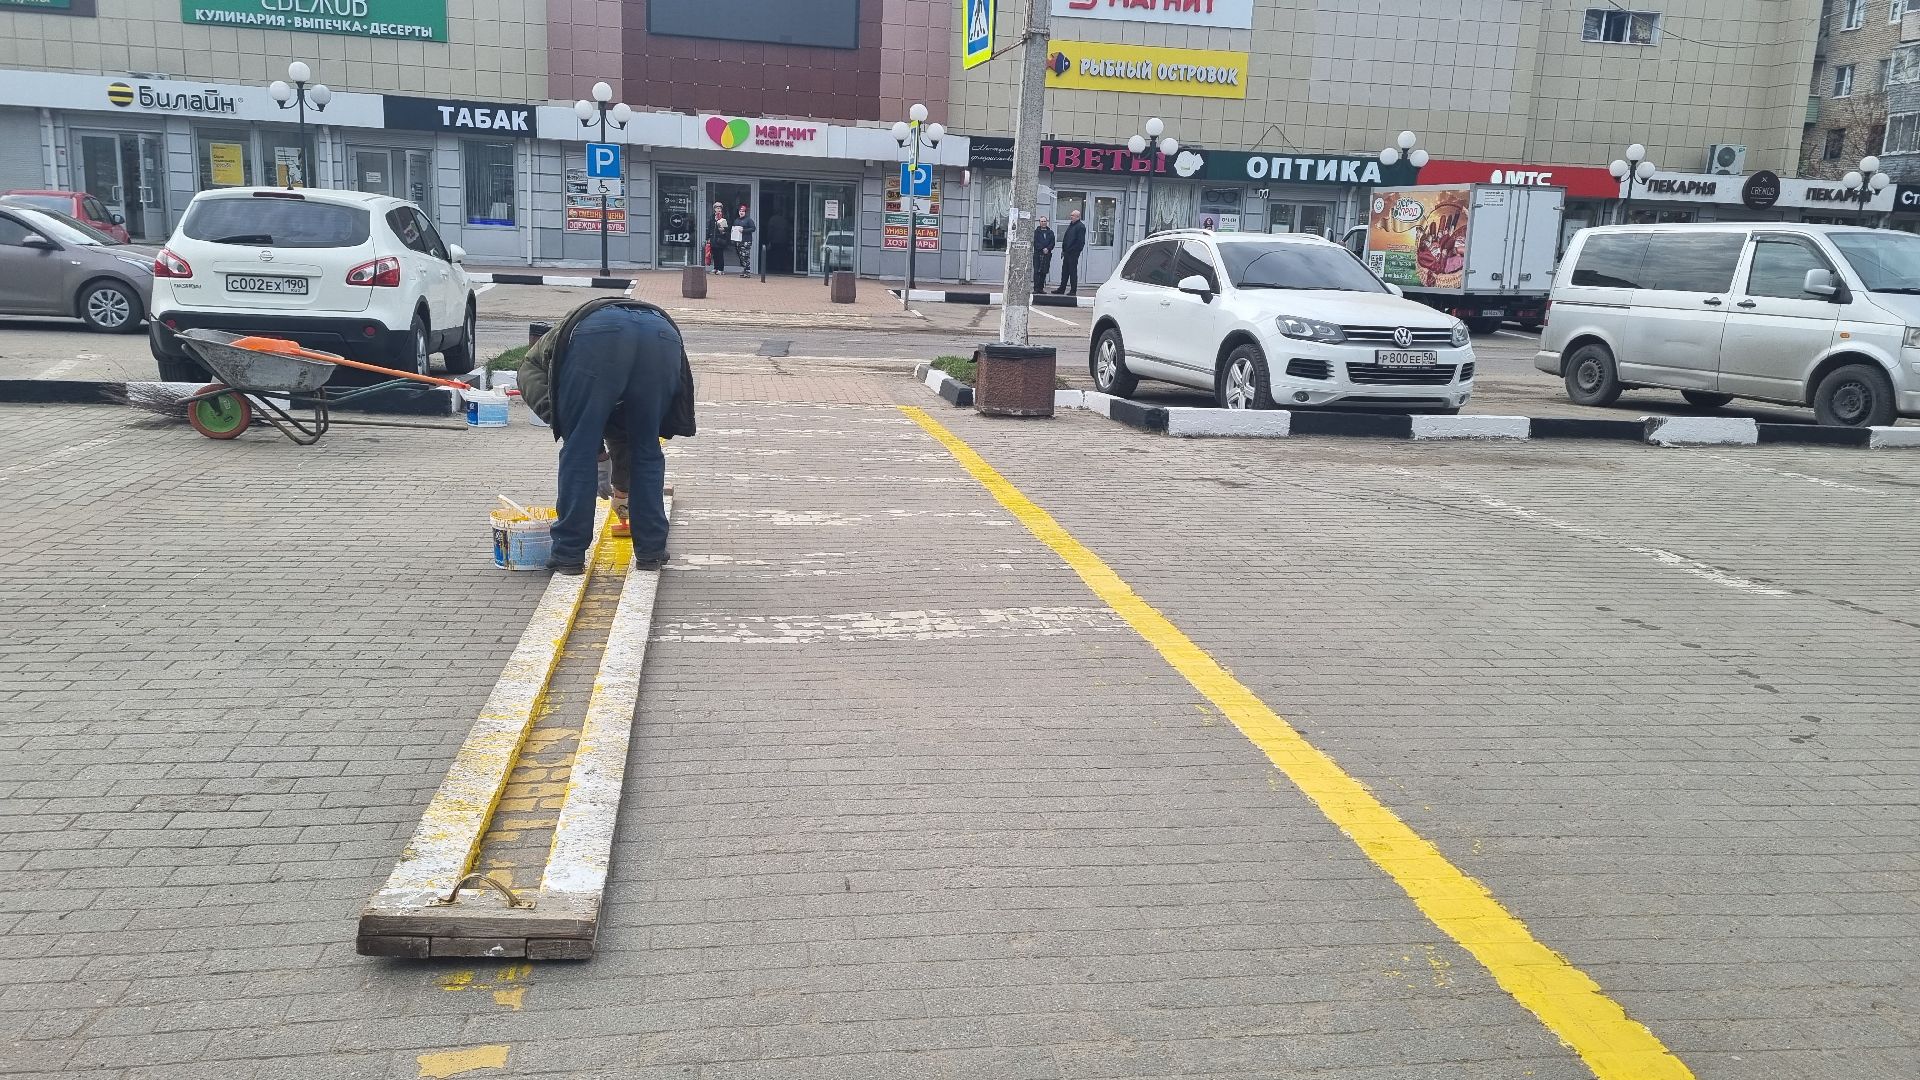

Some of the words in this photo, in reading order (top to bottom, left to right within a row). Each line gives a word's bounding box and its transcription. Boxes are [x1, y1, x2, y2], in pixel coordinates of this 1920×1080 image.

[195, 9, 285, 27] КУЛИНАРИЯ
[294, 17, 362, 32] ВЫПЕЧКА
[369, 22, 433, 38] ДЕСЕРТЫ
[1080, 58, 1153, 81] РЫБНЫЙ
[1157, 63, 1239, 86] ОСТРОВОК
[138, 85, 237, 113] Билайн
[437, 105, 529, 131] ТАБАК
[595, 147, 614, 175] P
[1039, 145, 1168, 173] ЦВЕТЫ
[1246, 156, 1382, 184] ОПТИКА
[1504, 170, 1553, 186] МТС
[1647, 179, 1717, 196] ПЕКАРНЯ
[1901, 190, 1920, 205] Ст
[578, 210, 603, 219] СМЕШНЫ
[569, 221, 596, 230] ОДЕЖДА
[606, 223, 625, 231] БУВЬ
[886, 227, 925, 236] УНИВЕАГ
[664, 232, 691, 243] TELE2
[886, 239, 936, 249] ХОЗТАРЫ
[284, 278, 304, 289] 190
[1423, 352, 1434, 361] 50
